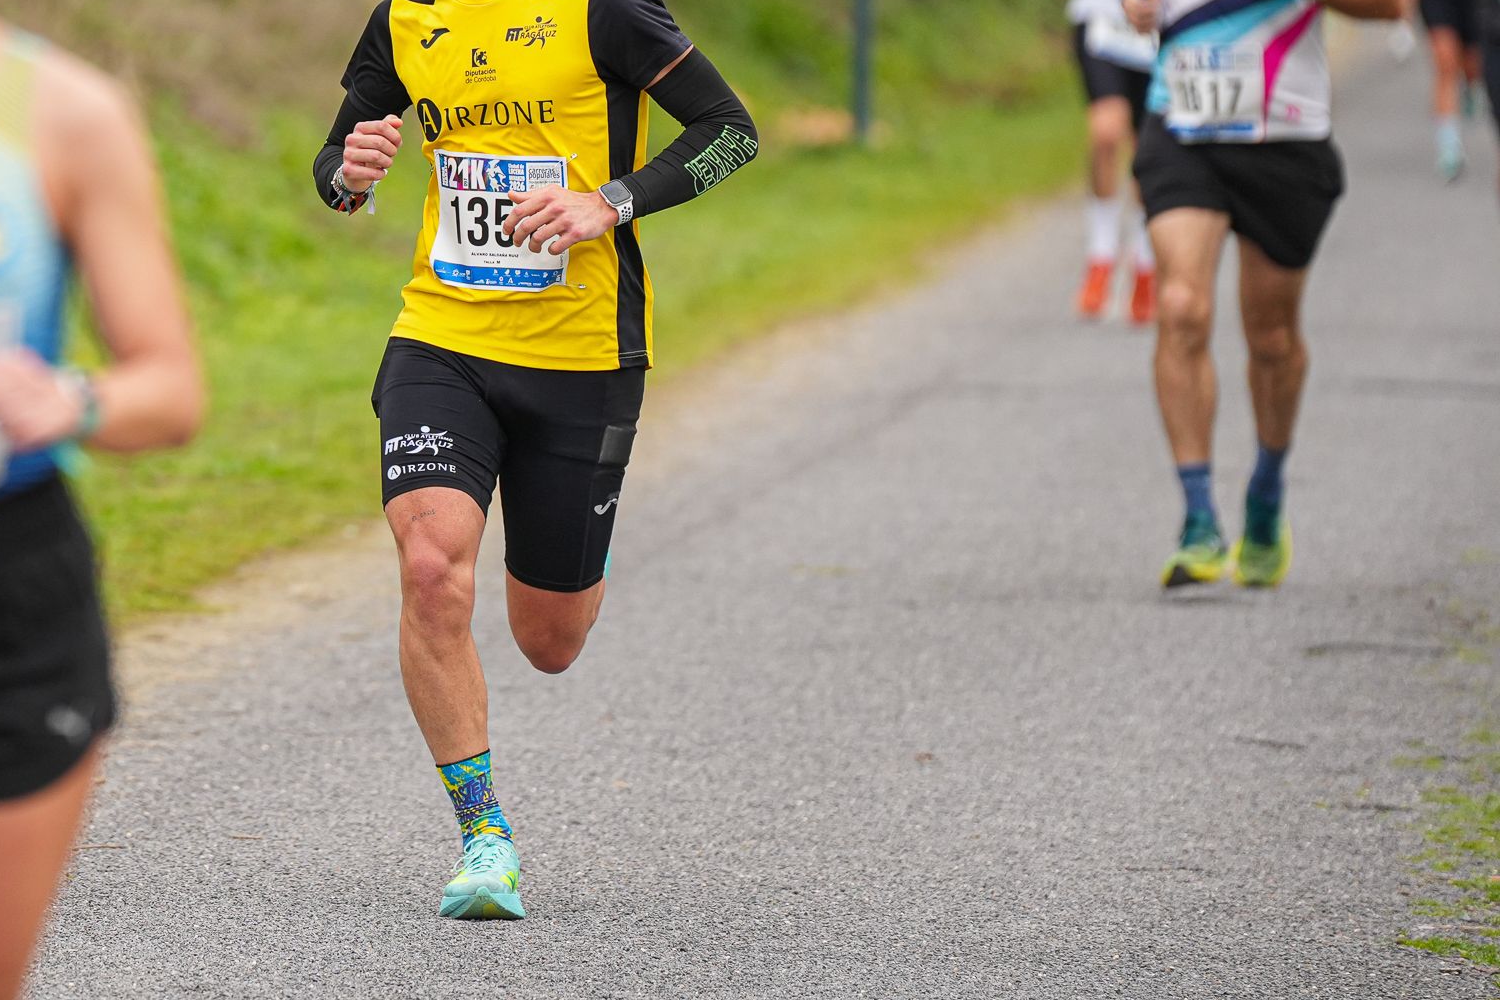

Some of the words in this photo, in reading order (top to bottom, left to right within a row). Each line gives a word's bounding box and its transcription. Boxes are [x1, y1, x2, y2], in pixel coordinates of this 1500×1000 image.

[465, 68, 496, 77] Diputación
[418, 99, 556, 140] AIRZONE
[447, 158, 487, 190] 21K
[528, 172, 560, 180] populares
[450, 196, 517, 248] 135
[420, 433, 454, 443] ATLETISMO
[387, 463, 457, 480] AIRZONE
